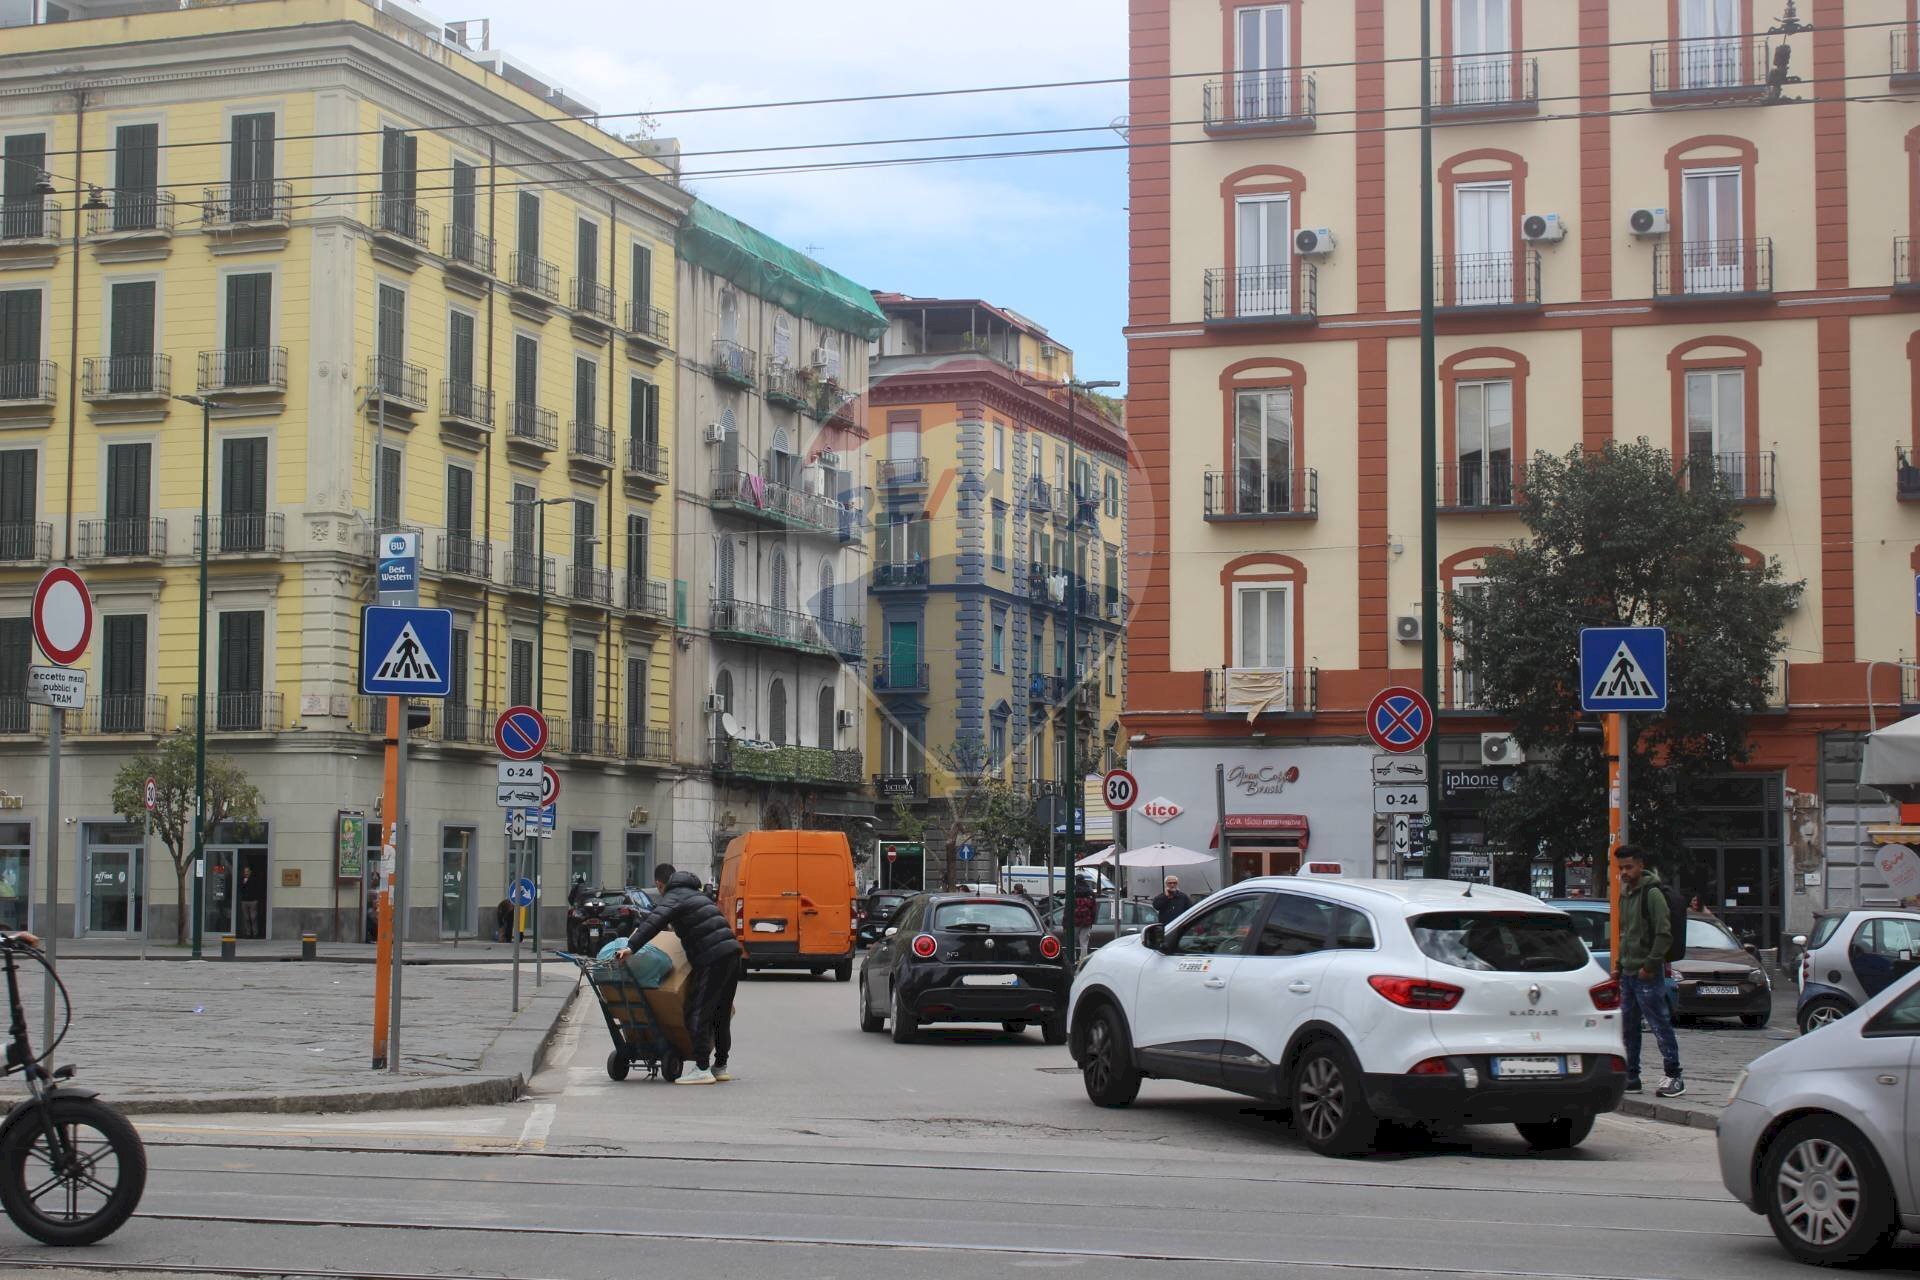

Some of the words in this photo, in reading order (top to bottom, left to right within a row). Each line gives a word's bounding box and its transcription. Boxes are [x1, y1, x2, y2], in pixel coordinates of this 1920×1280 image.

[389, 566, 405, 574] Best
[381, 573, 413, 581] Western
[33, 673, 66, 681] eccetto
[43, 683, 71, 692] pubblici
[51, 693, 72, 703] TRAM
[507, 768, 533, 777] 0-24
[1447, 771, 1499, 789] iphone
[1109, 781, 1130, 800] 30
[1386, 794, 1418, 805] 0-24
[1145, 802, 1178, 816] tico
